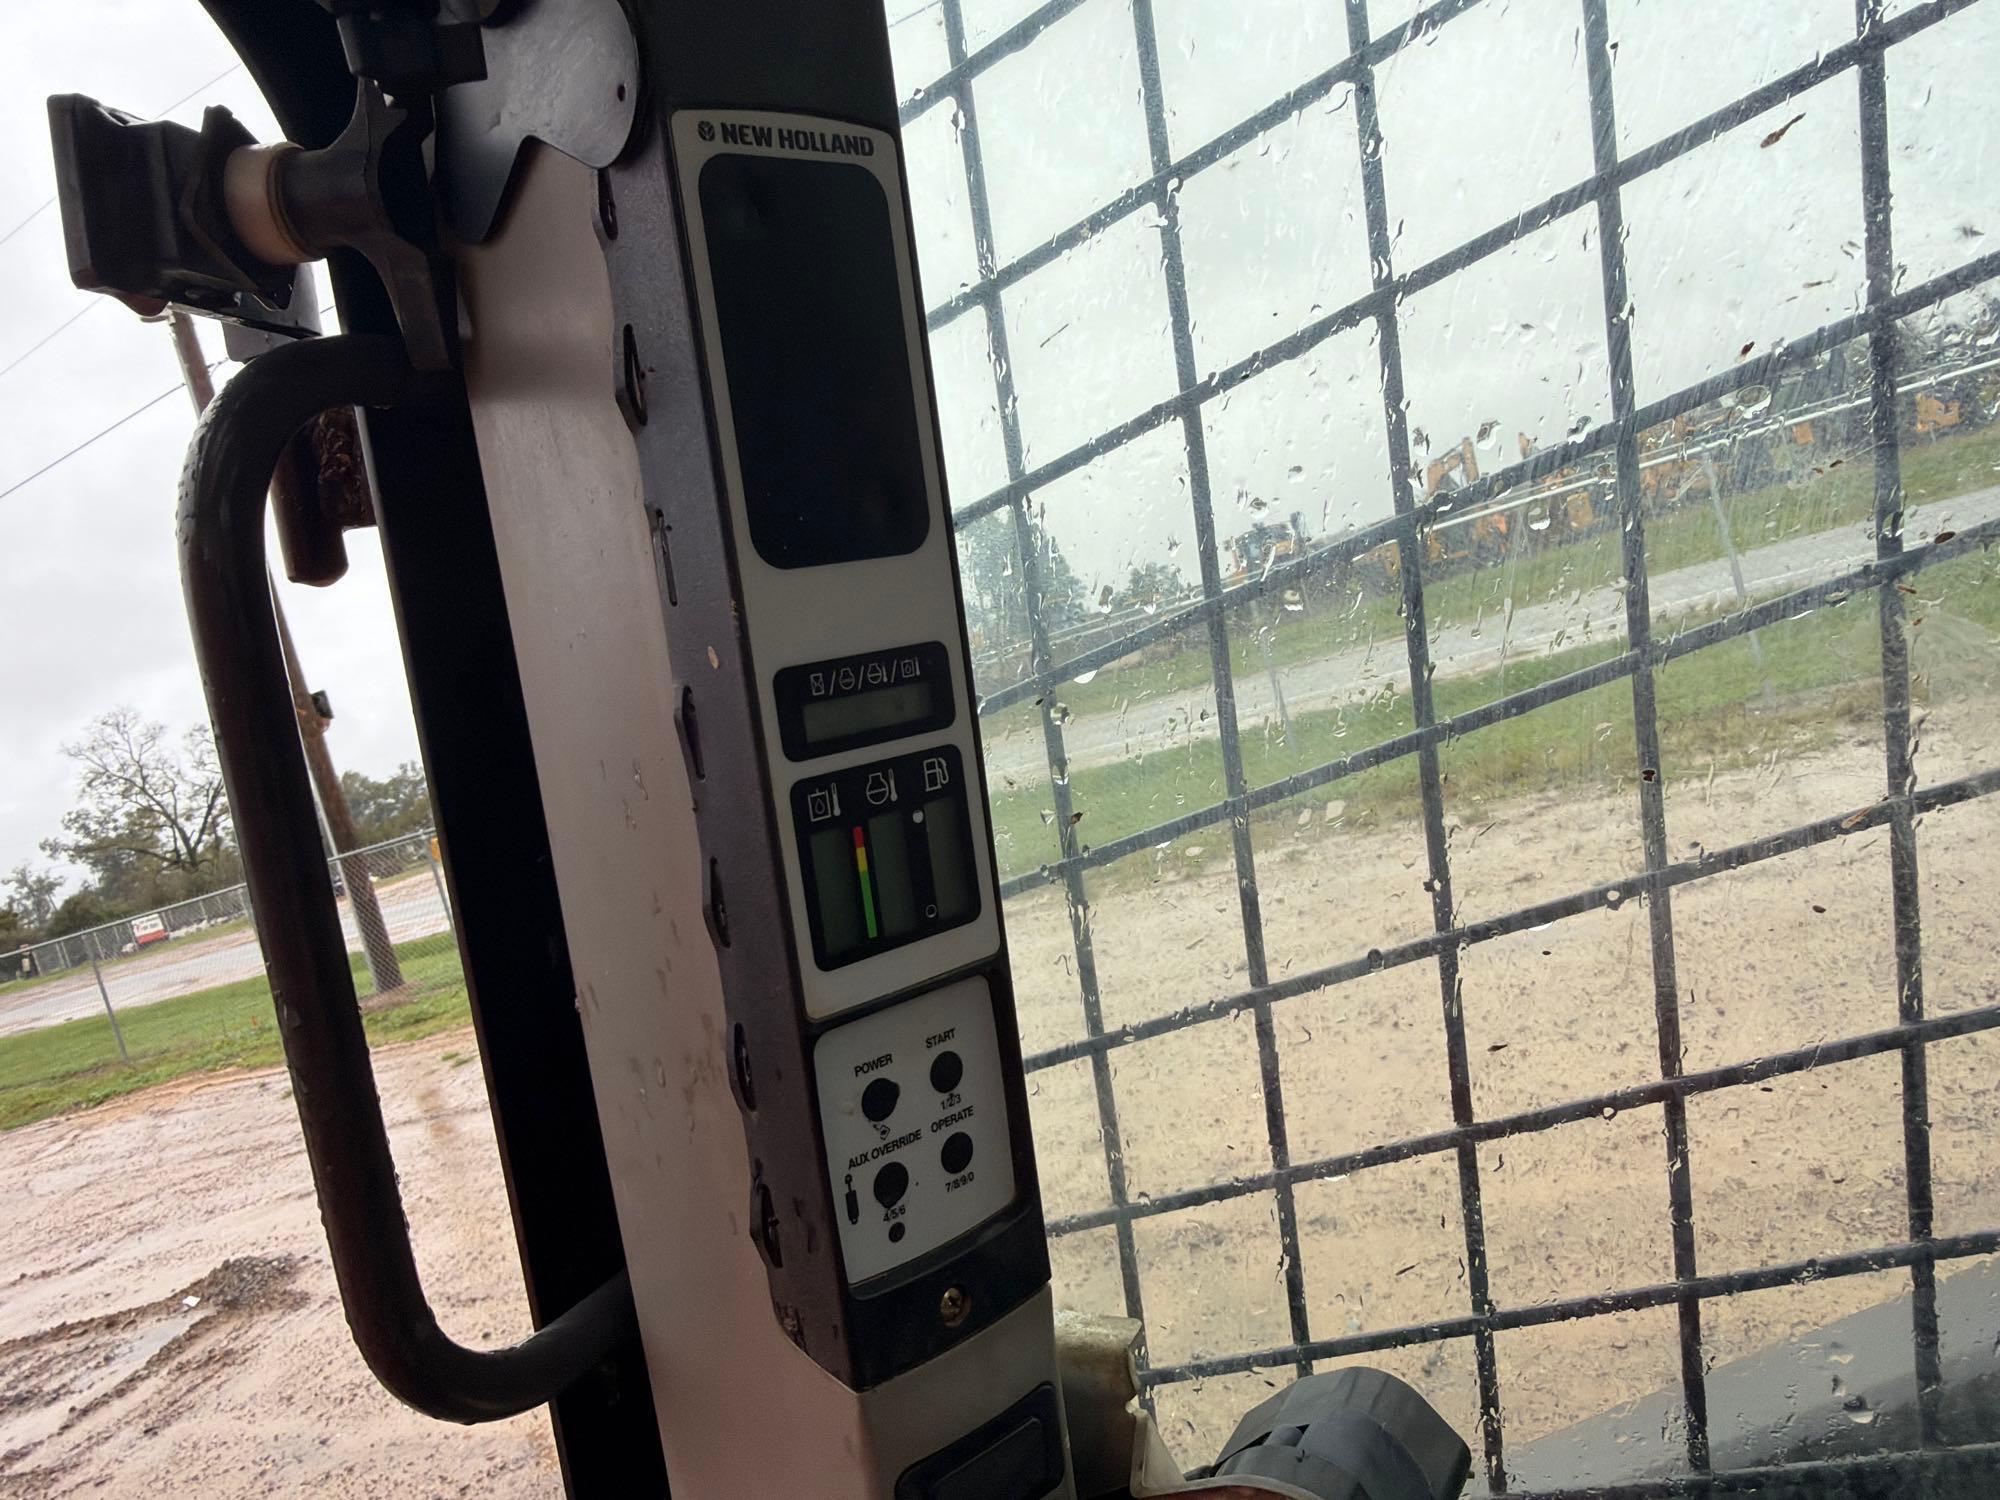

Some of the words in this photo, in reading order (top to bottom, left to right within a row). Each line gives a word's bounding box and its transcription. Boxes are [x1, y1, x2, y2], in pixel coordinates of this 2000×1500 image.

[720, 122, 772, 148] NEW
[778, 128, 874, 156] HOLLAND
[925, 1028, 956, 1049] START
[854, 1053, 893, 1077] POWER
[940, 1094, 962, 1110] 1/2/3
[931, 1105, 974, 1133] OPERATE
[848, 1152, 871, 1170] AUX
[871, 1129, 922, 1160] OVERRIDE
[945, 1171, 974, 1193] 7/8/9/0
[883, 1204, 906, 1222] 4/5/6
